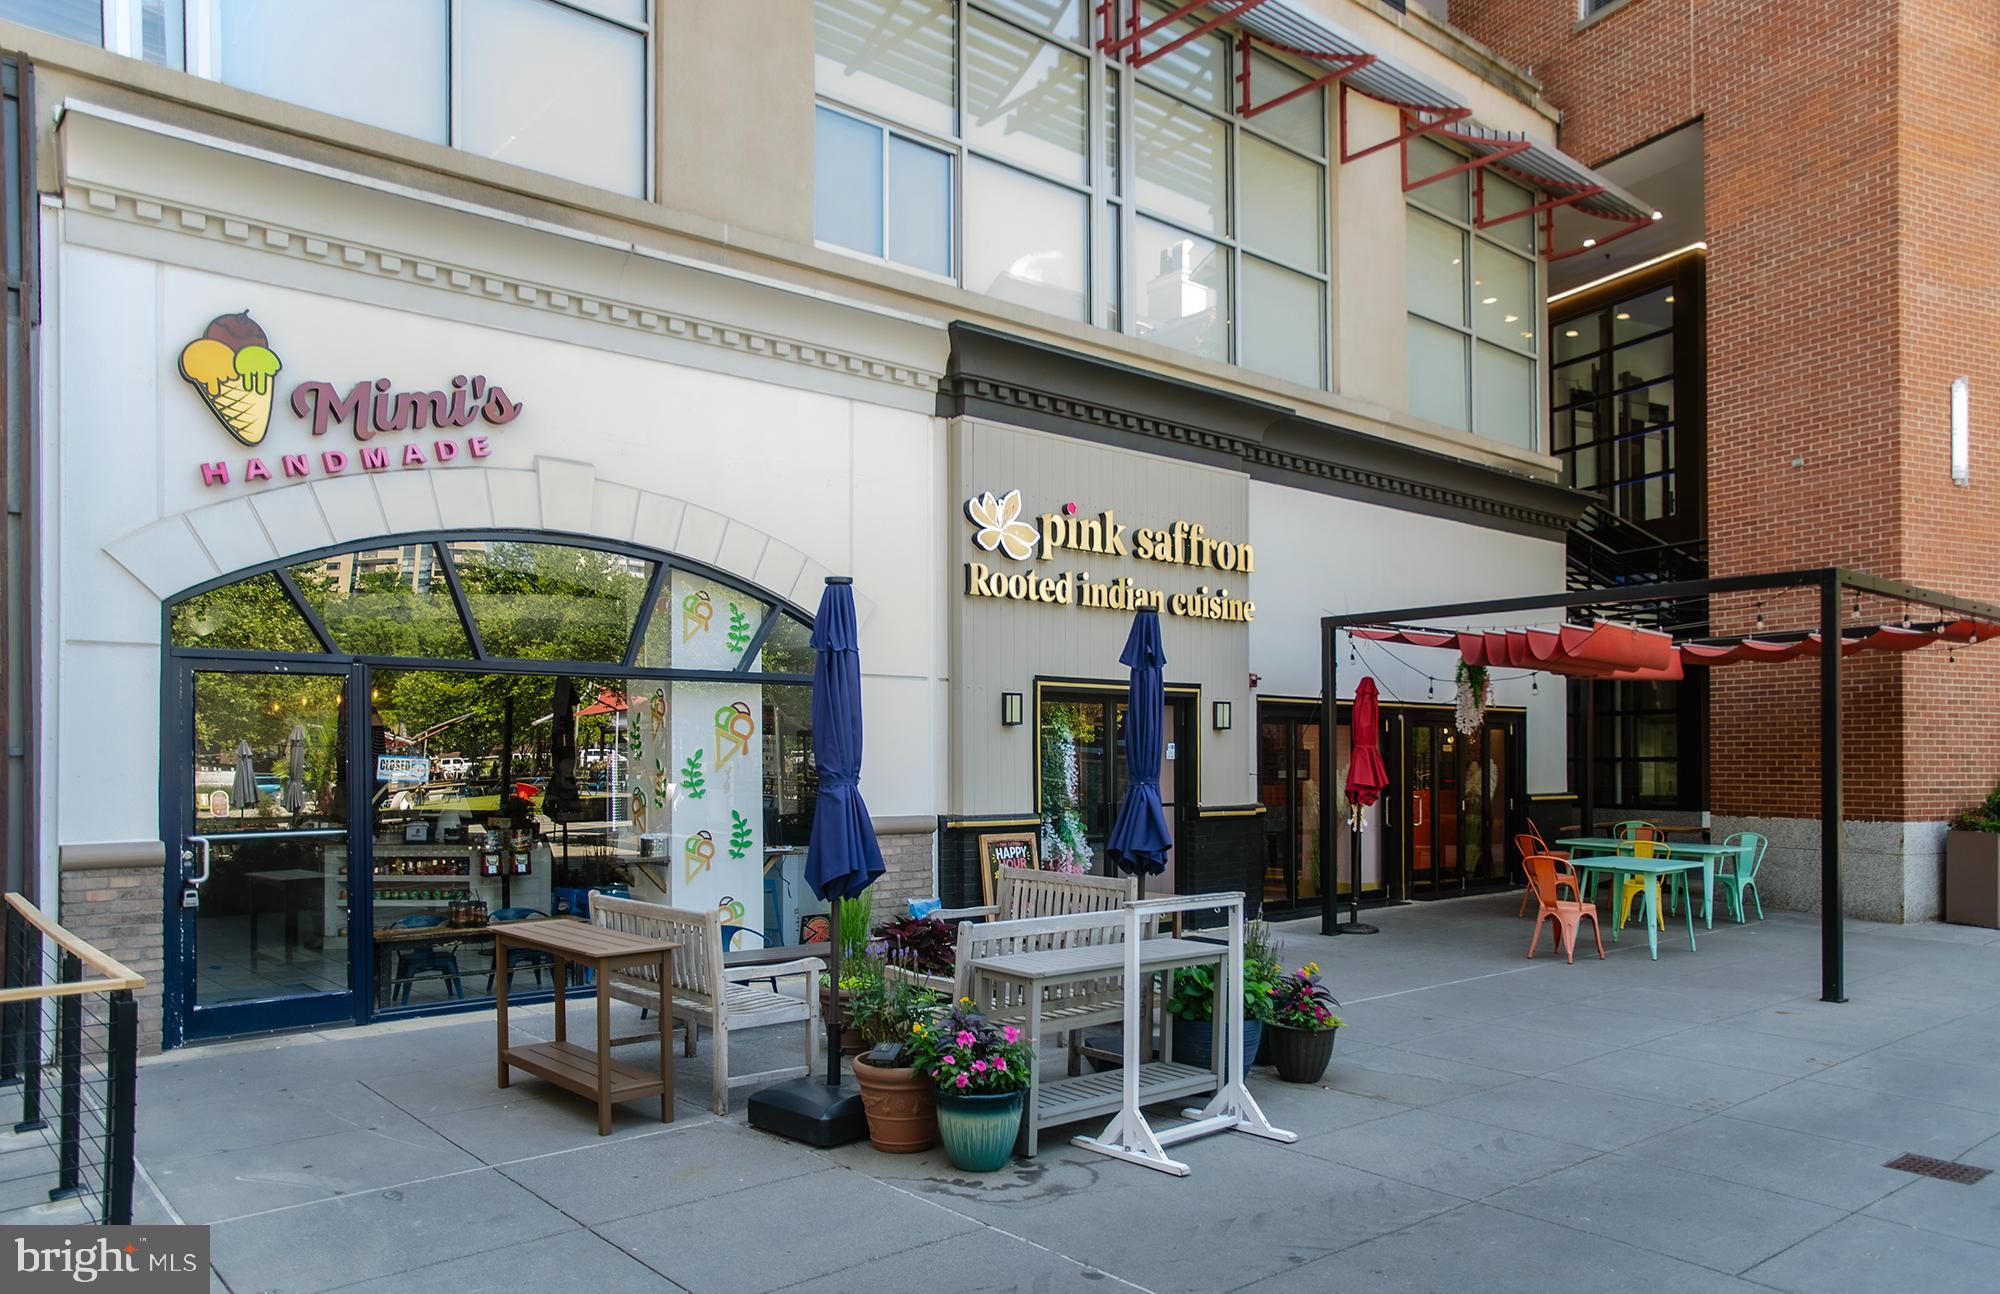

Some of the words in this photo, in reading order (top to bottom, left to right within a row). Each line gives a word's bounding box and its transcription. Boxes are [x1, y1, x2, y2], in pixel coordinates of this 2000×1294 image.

[291, 374, 523, 441] Mimi's
[200, 436, 492, 486] HANDMADE
[1036, 501, 1128, 561] pink
[1133, 520, 1256, 573] saffron
[964, 562, 1073, 605] Rooted
[1077, 571, 1166, 612] indian
[1167, 586, 1256, 623] cuisine
[380, 759, 411, 771] CLOSED
[995, 845, 1027, 860] HAPPY
